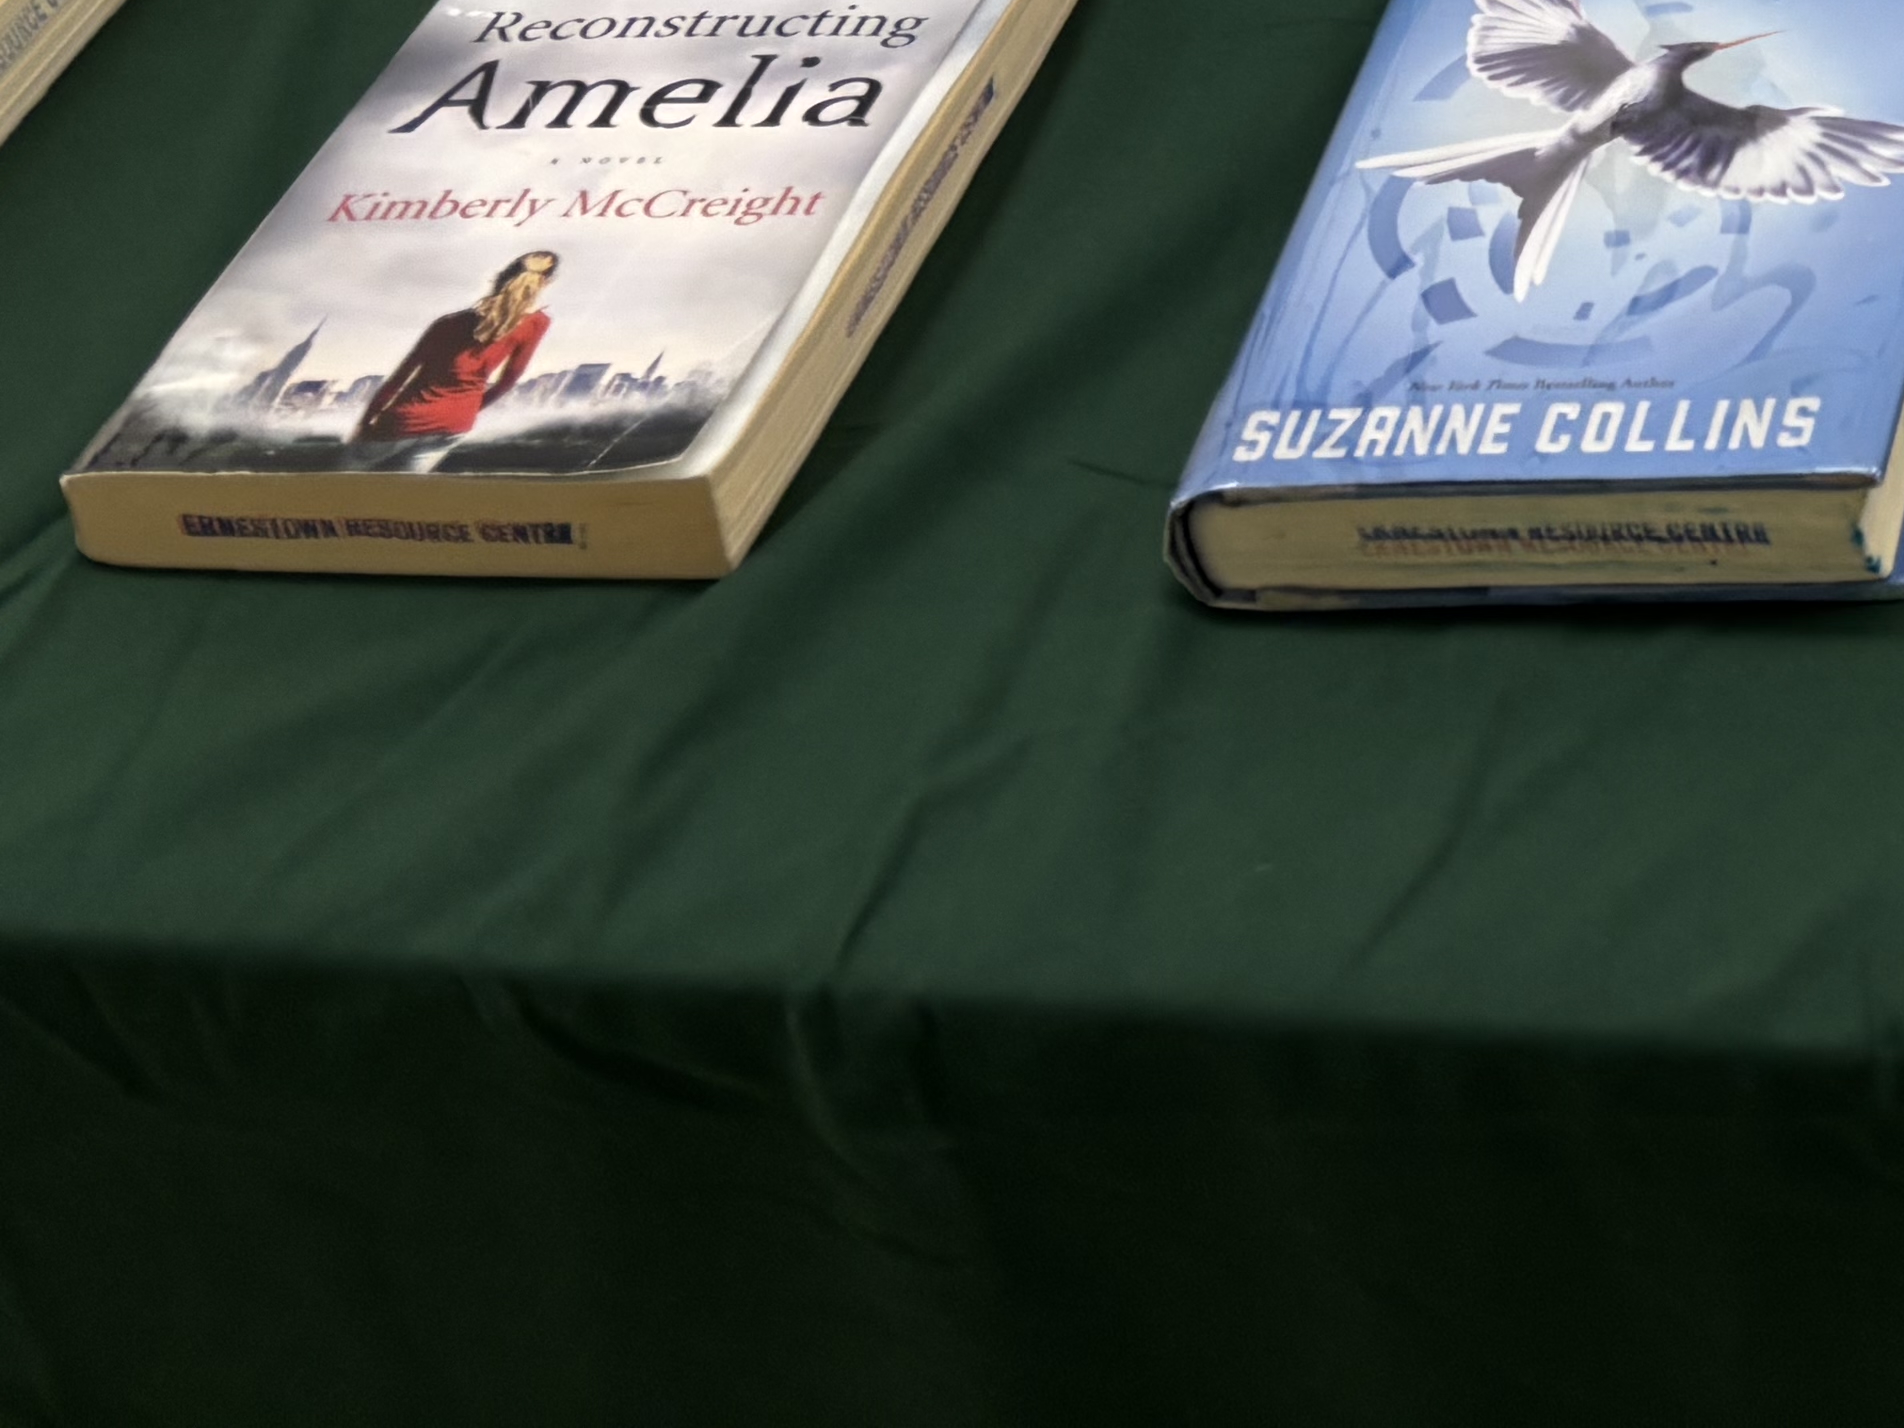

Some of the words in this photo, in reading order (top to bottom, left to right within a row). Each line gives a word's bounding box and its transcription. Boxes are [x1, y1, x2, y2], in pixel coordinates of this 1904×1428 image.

[473, 4, 929, 48] Reconstructing
[387, 54, 884, 134] Amelia
[581, 156, 668, 165] NOVEL
[326, 186, 557, 226] Kimberly
[561, 185, 827, 225] McCreight
[1231, 401, 1523, 463] SUZANNE
[1533, 395, 1823, 454] COLLINS
[178, 513, 338, 540] ERNESTOWN
[345, 518, 472, 543] RESOURCE
